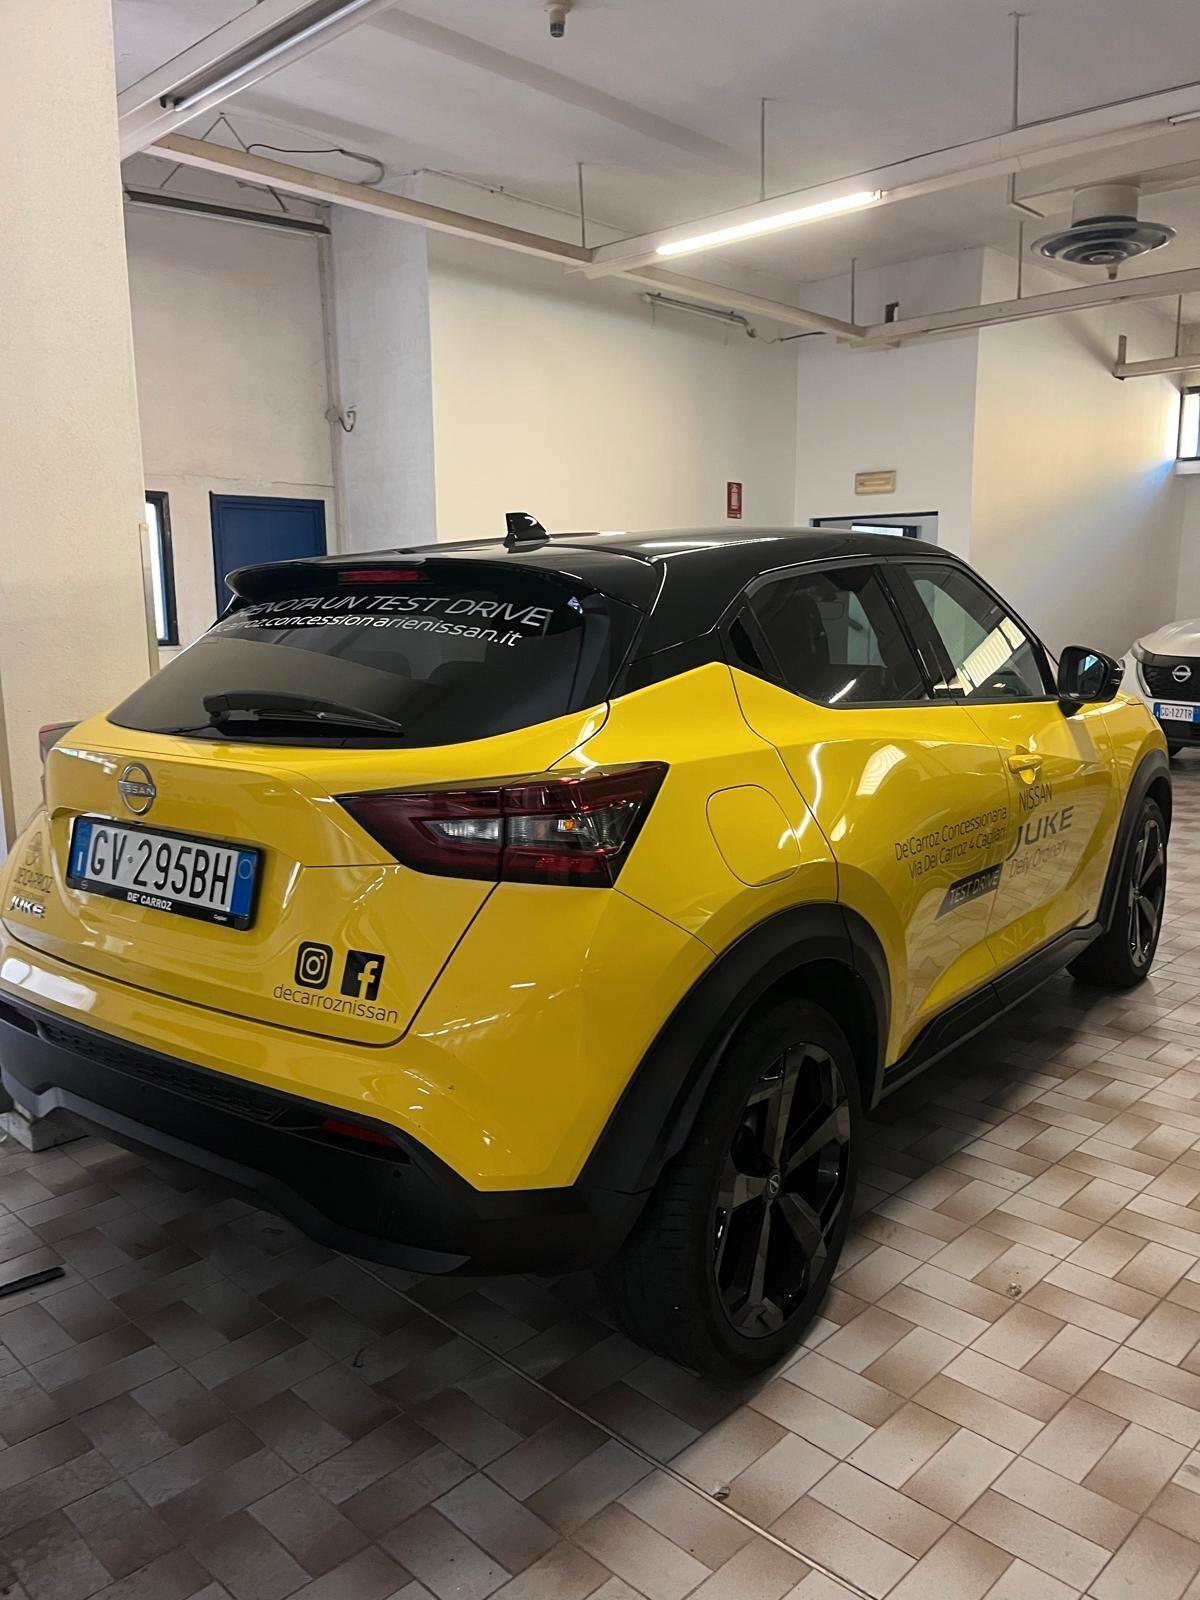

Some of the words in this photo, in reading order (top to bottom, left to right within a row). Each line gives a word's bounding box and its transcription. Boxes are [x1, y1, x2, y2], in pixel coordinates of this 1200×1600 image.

[236, 597, 325, 616] ENOTA
[321, 596, 368, 609] UN
[366, 596, 450, 612] TEST
[445, 599, 554, 627] DRIVE
[214, 614, 522, 646] carroz.concessionarienissan.it
[1019, 784, 1052, 811] NISSAN
[1005, 805, 1074, 861] JUKE
[909, 861, 922, 879] Via
[940, 842, 967, 864] Carroz
[140, 895, 172, 911] CARROZ
[949, 881, 973, 906] TEST
[972, 869, 1001, 896] DRIVE
[8, 895, 46, 919] JUKE
[273, 984, 398, 1024] decarroznissan
